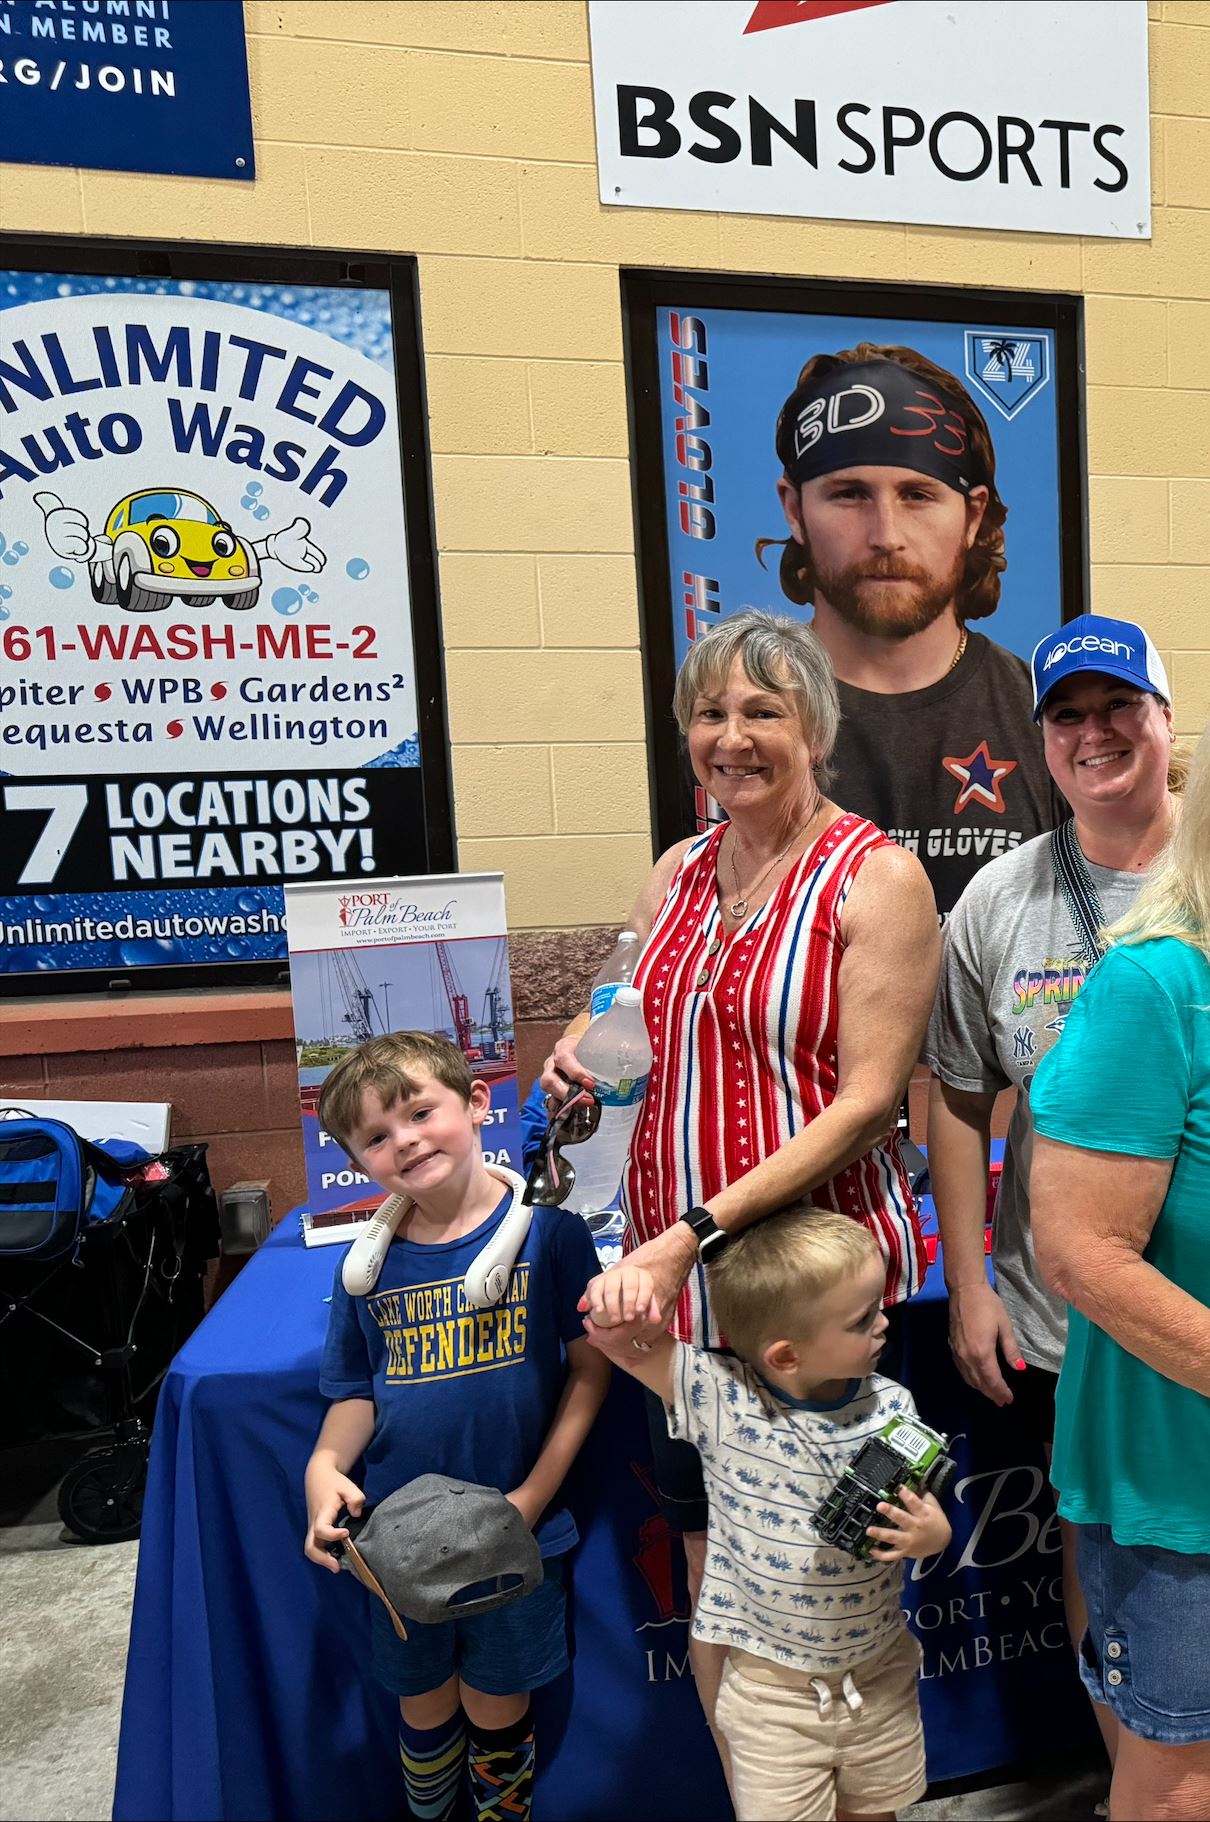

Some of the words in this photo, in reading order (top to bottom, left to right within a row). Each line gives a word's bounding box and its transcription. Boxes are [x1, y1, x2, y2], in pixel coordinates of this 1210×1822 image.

[31, 16, 173, 49] MEMBER
[616, 84, 818, 170] BSN
[836, 102, 1129, 193] SPORTS
[0, 324, 387, 446] NLIMITED
[669, 311, 717, 540] GLOVES
[0, 411, 143, 500] Auto
[168, 398, 349, 508] Wash
[3, 625, 378, 661] 61-WASH-ME-2
[1043, 635, 1131, 672] 4ocean
[122, 679, 204, 705] WPB
[3, 717, 154, 750] equesta
[193, 714, 388, 745] Wellington
[105, 776, 371, 829] LOCATIONS
[3, 785, 89, 884] 7
[110, 828, 377, 881] NEARBY!
[927, 827, 1023, 857] GLOVES
[352, 893, 391, 906] PORT
[352, 904, 398, 927] Palm
[399, 900, 458, 924] Beach
[0, 908, 288, 945] nlimitedautowash
[341, 929, 371, 937] IMPORT
[378, 926, 407, 935] EXPORT
[413, 924, 435, 932] YOUR
[1012, 967, 1092, 1015] SPRIN
[367, 1295, 402, 1327] LAKE
[404, 1286, 452, 1322] WORTH
[384, 1306, 528, 1375] DEFENDERS
[918, 1622, 1073, 1681] LMBEAC
